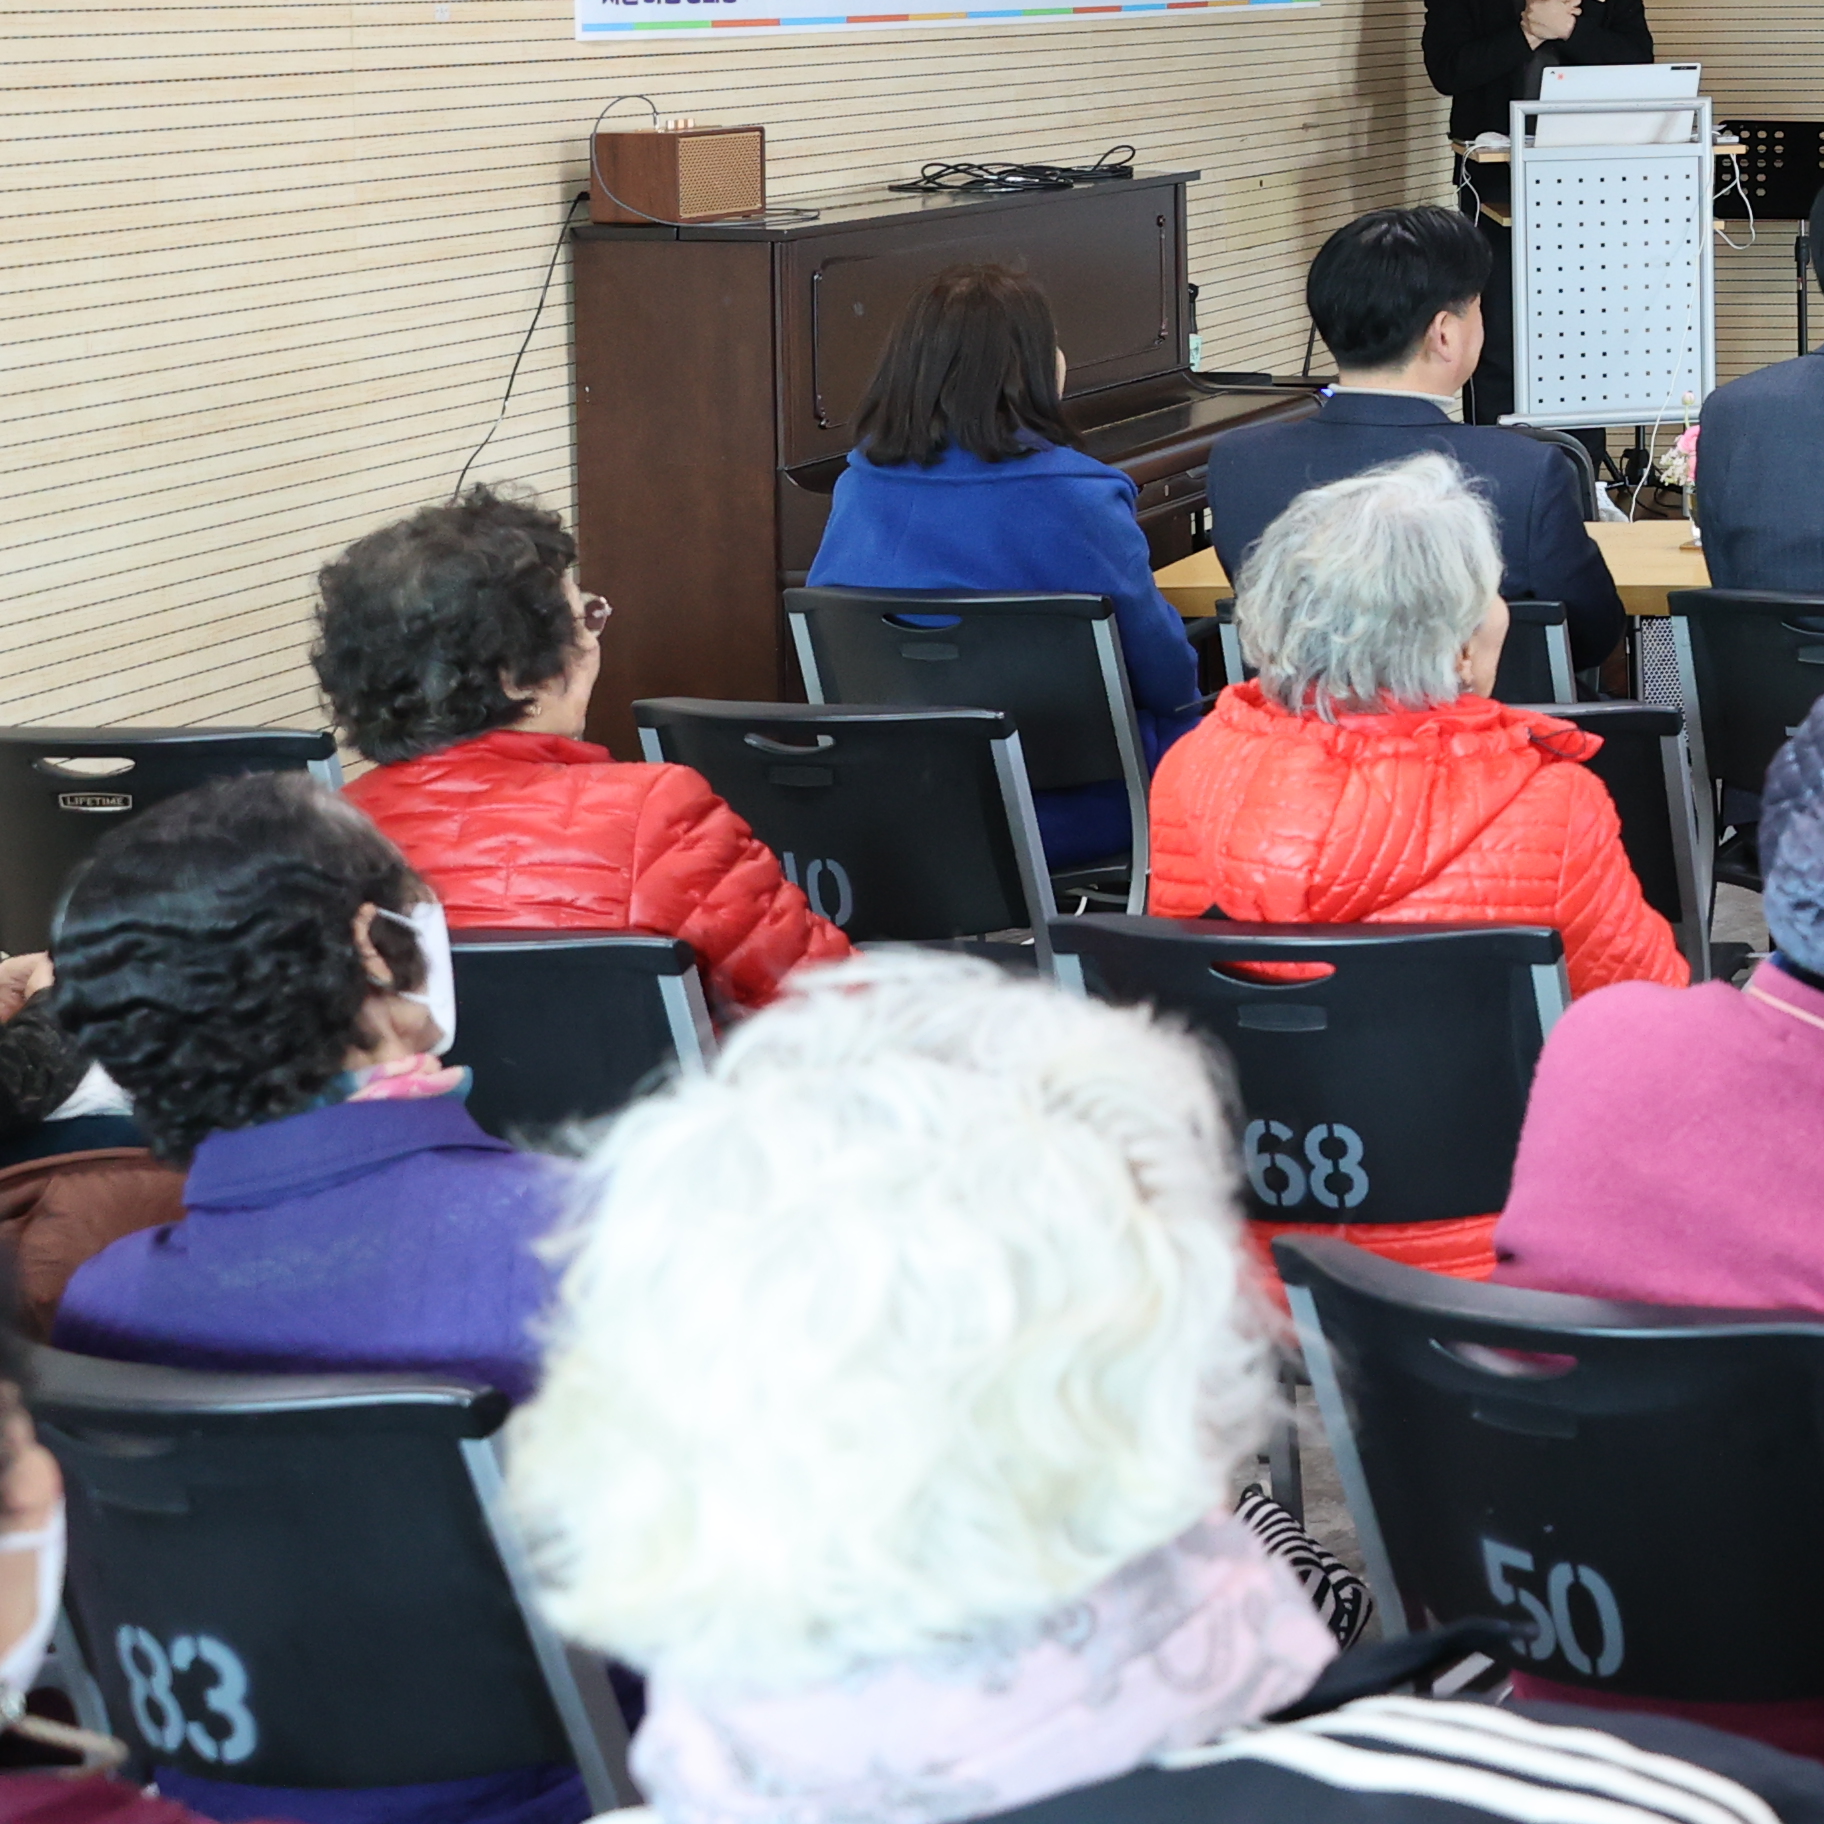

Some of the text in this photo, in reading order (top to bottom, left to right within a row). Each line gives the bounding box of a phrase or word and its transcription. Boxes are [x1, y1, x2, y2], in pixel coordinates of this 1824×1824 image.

[67, 796, 124, 806] LIFETIME
[1243, 1118, 1370, 1210] 68
[1480, 1537, 1626, 1678] 50
[115, 1625, 260, 1764] 83
